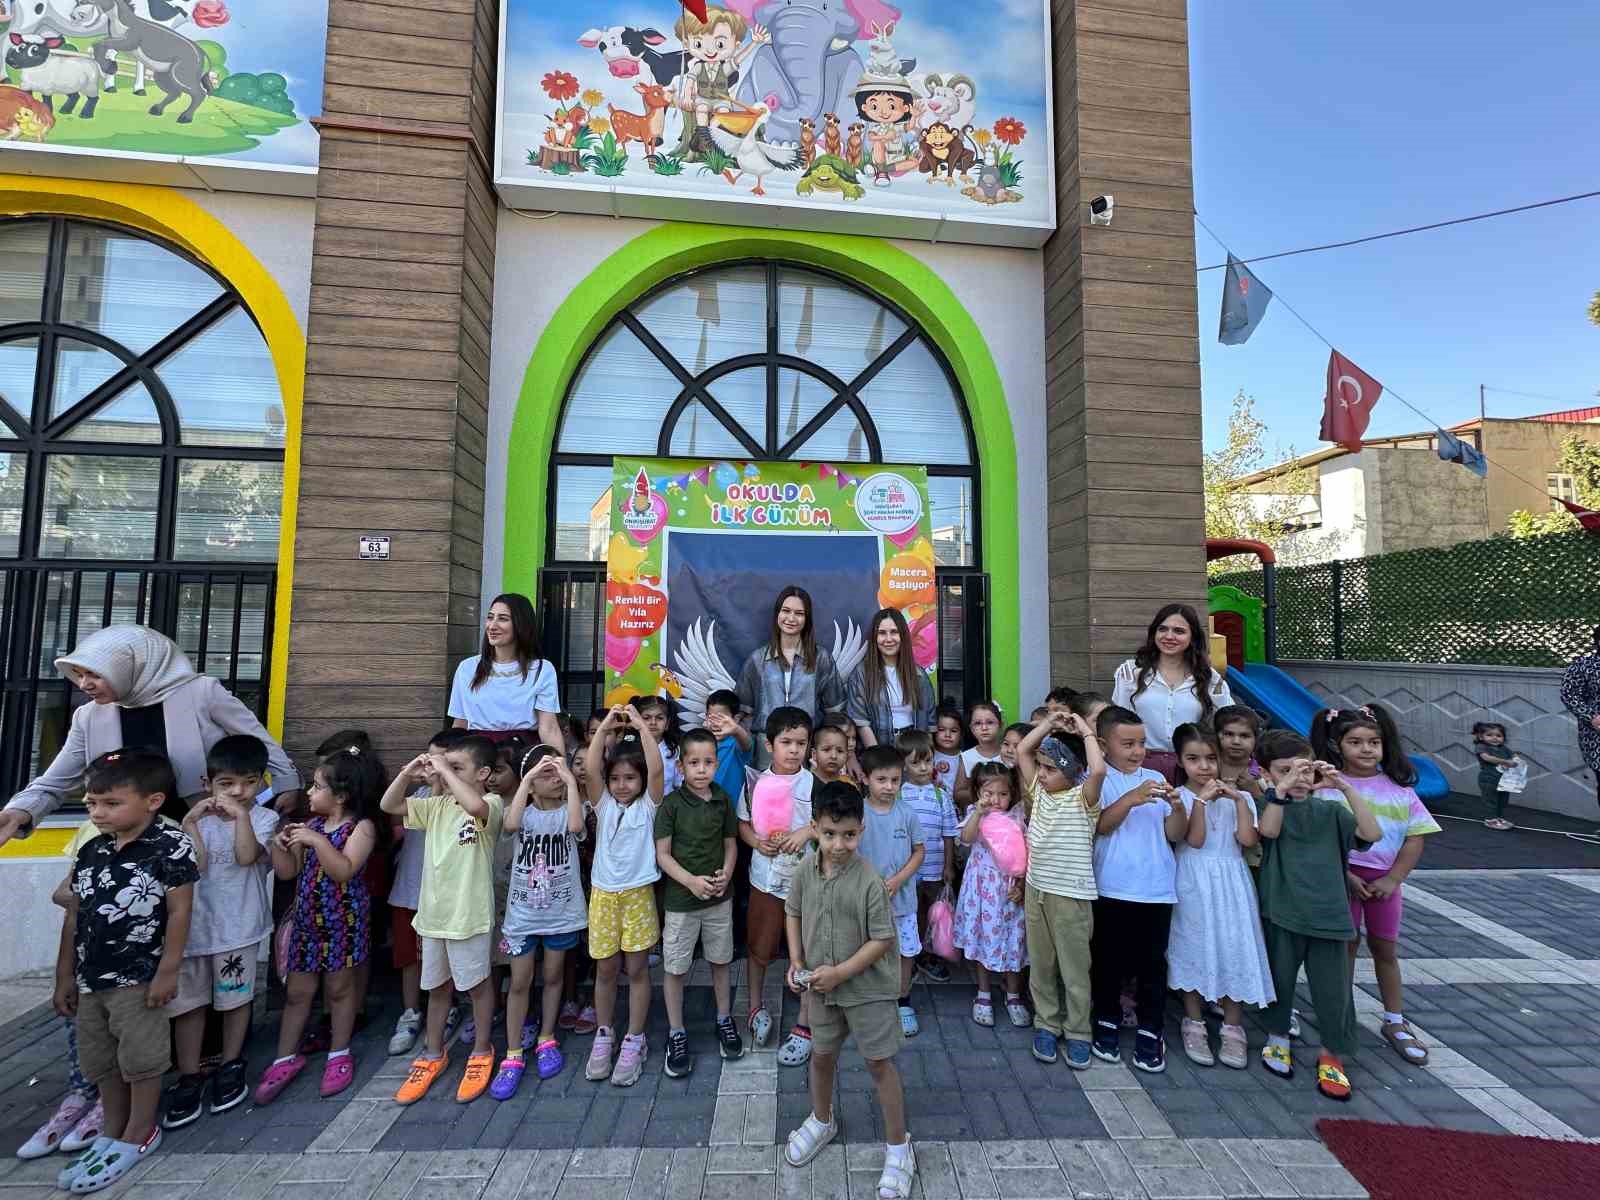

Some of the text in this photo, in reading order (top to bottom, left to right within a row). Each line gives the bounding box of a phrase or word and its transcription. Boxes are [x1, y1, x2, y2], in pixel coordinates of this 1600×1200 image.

[727, 483, 815, 502] OKULDA
[711, 503, 831, 525] İLK GÜNÜM
[368, 542, 381, 552] 63
[890, 567, 927, 577] Macera
[888, 579, 930, 591] Başlıyor
[615, 595, 661, 605] Renkli Bir
[629, 607, 647, 617] Yıla
[620, 619, 656, 629] Hazırız
